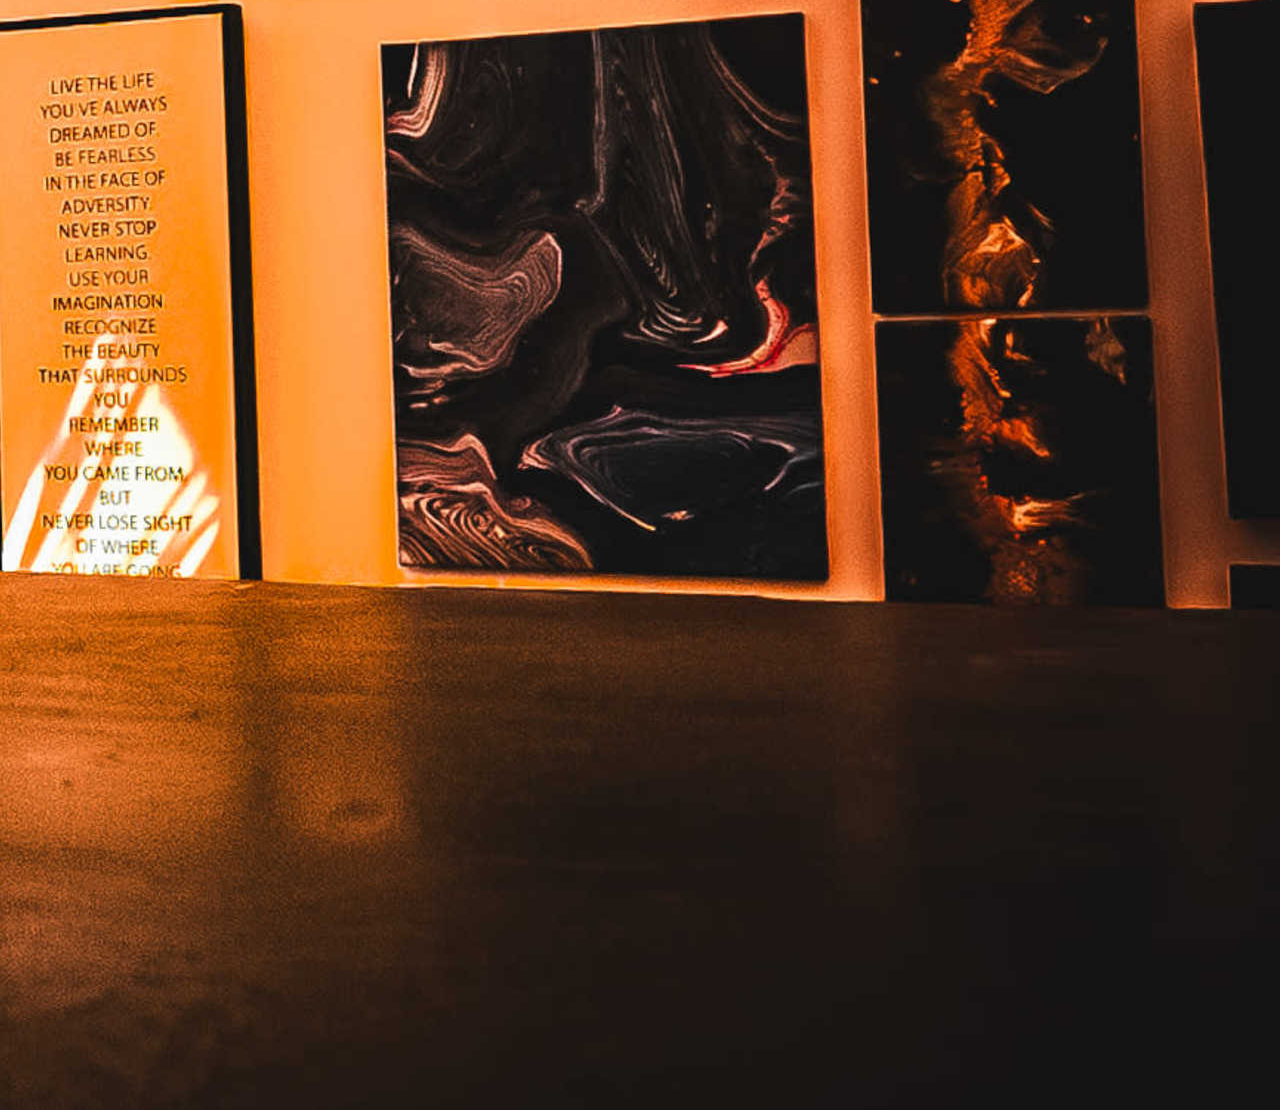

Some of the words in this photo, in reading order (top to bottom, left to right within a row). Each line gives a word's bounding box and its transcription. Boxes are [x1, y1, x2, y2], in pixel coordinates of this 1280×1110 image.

[50, 77, 83, 95] LIVE
[88, 75, 118, 91] THE
[123, 72, 155, 89] LIFE
[103, 96, 168, 115] ALWAYS
[50, 123, 130, 144] DREAMED
[55, 151, 73, 167] BE
[78, 146, 156, 165] FEARLESS
[45, 176, 62, 191] IN
[66, 174, 96, 189] THE
[100, 172, 140, 187] FACE
[145, 170, 166, 186] OF
[59, 222, 110, 238] NEVER
[115, 220, 156, 236] STOP
[69, 271, 100, 287] USE
[104, 269, 149, 285] YOUR
[64, 318, 157, 335] RECOGNIZE
[62, 344, 93, 359] THE
[98, 343, 160, 359] BEAUTY
[38, 368, 78, 383] THAT
[84, 367, 188, 383] SURROUNDS
[69, 417, 159, 433] REMEMBER
[84, 441, 144, 457] WHERE
[44, 465, 78, 481] YOU
[83, 466, 130, 481] CAME
[100, 490, 131, 506] BUT
[42, 514, 94, 530] NEVER
[99, 514, 138, 531] LOSE
[144, 515, 193, 531] SIGHT
[76, 538, 97, 554] OF
[101, 540, 159, 556] WHERE
[127, 563, 182, 578] GOING
